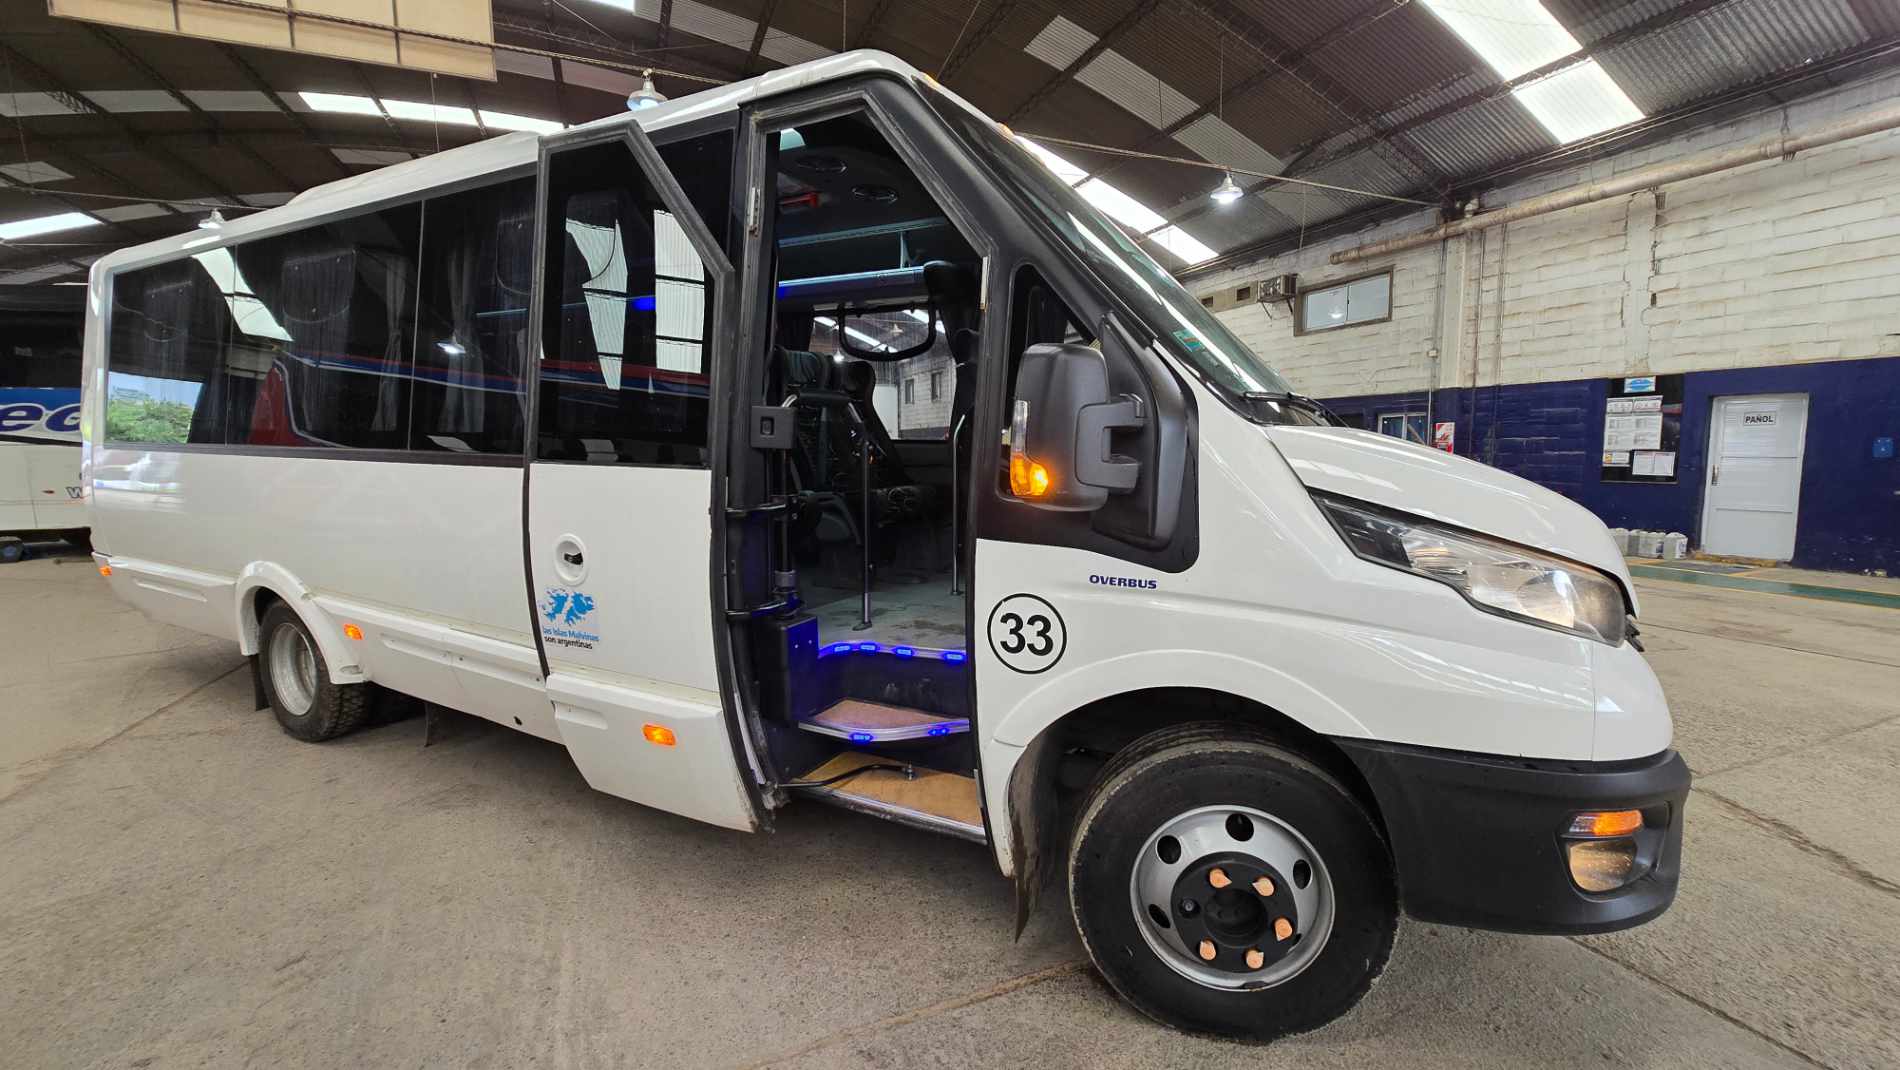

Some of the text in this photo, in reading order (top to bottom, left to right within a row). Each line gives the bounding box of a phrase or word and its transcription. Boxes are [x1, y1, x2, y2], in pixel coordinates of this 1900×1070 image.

[1089, 574, 1157, 589] OVERBUS
[1000, 612, 1053, 656] 33
[544, 636, 592, 649] son argentinas
